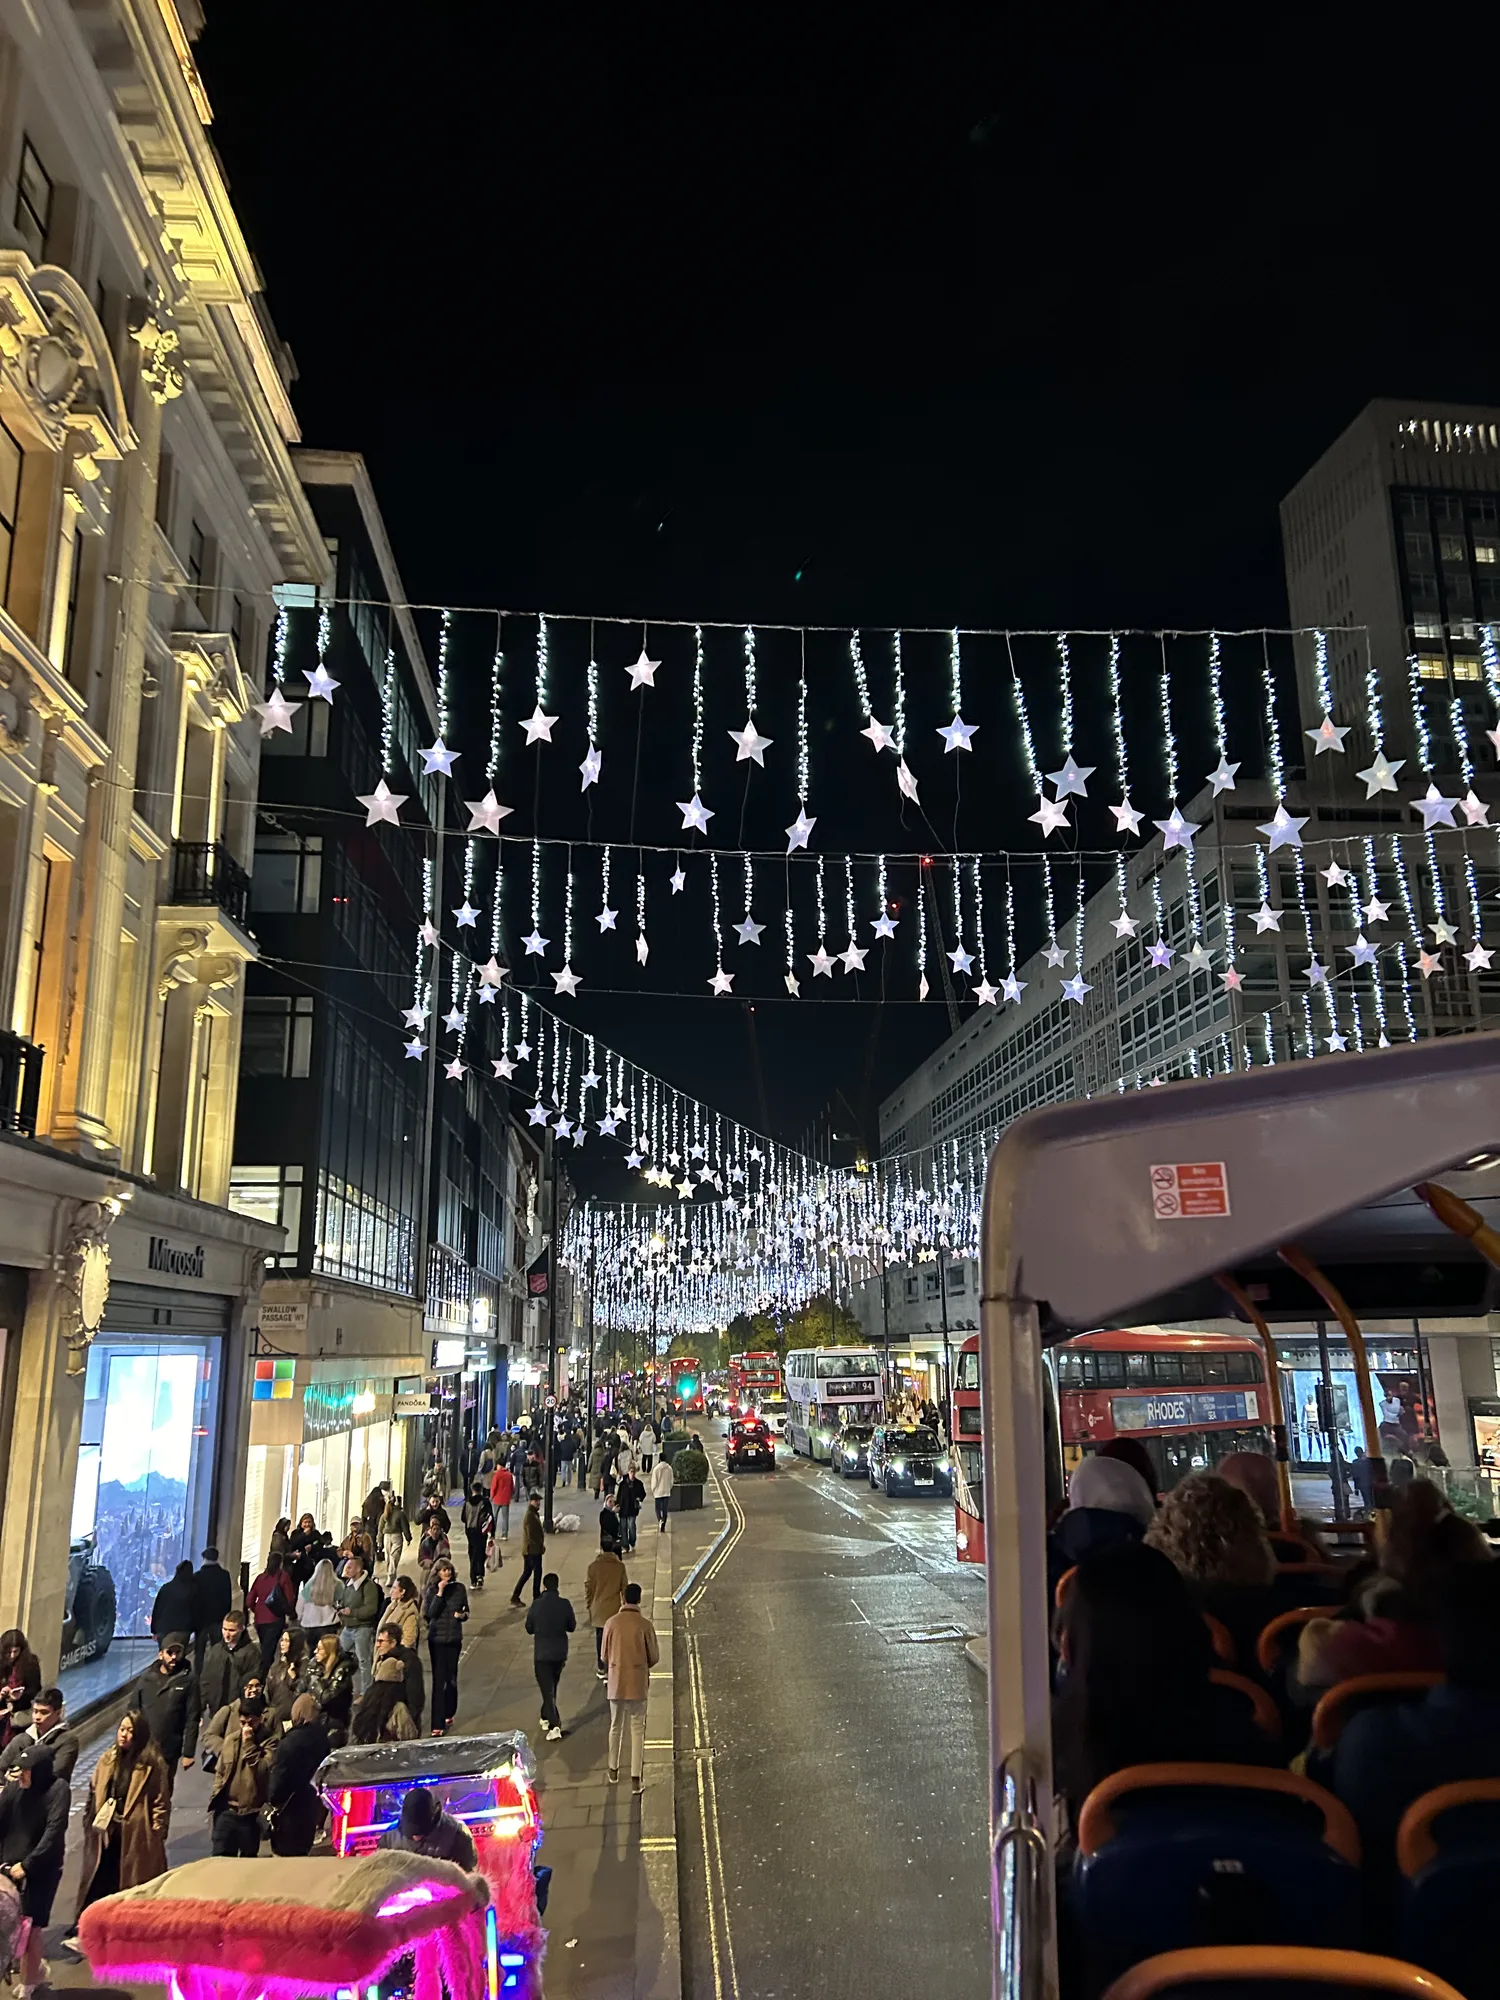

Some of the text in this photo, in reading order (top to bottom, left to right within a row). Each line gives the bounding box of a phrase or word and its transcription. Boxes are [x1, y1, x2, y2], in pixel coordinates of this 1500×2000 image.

[149, 1236, 204, 1278] Microsoft
[862, 1382, 872, 1390] 94
[1147, 1401, 1185, 1420] RHODES
[80, 1639, 97, 1659] PASS
